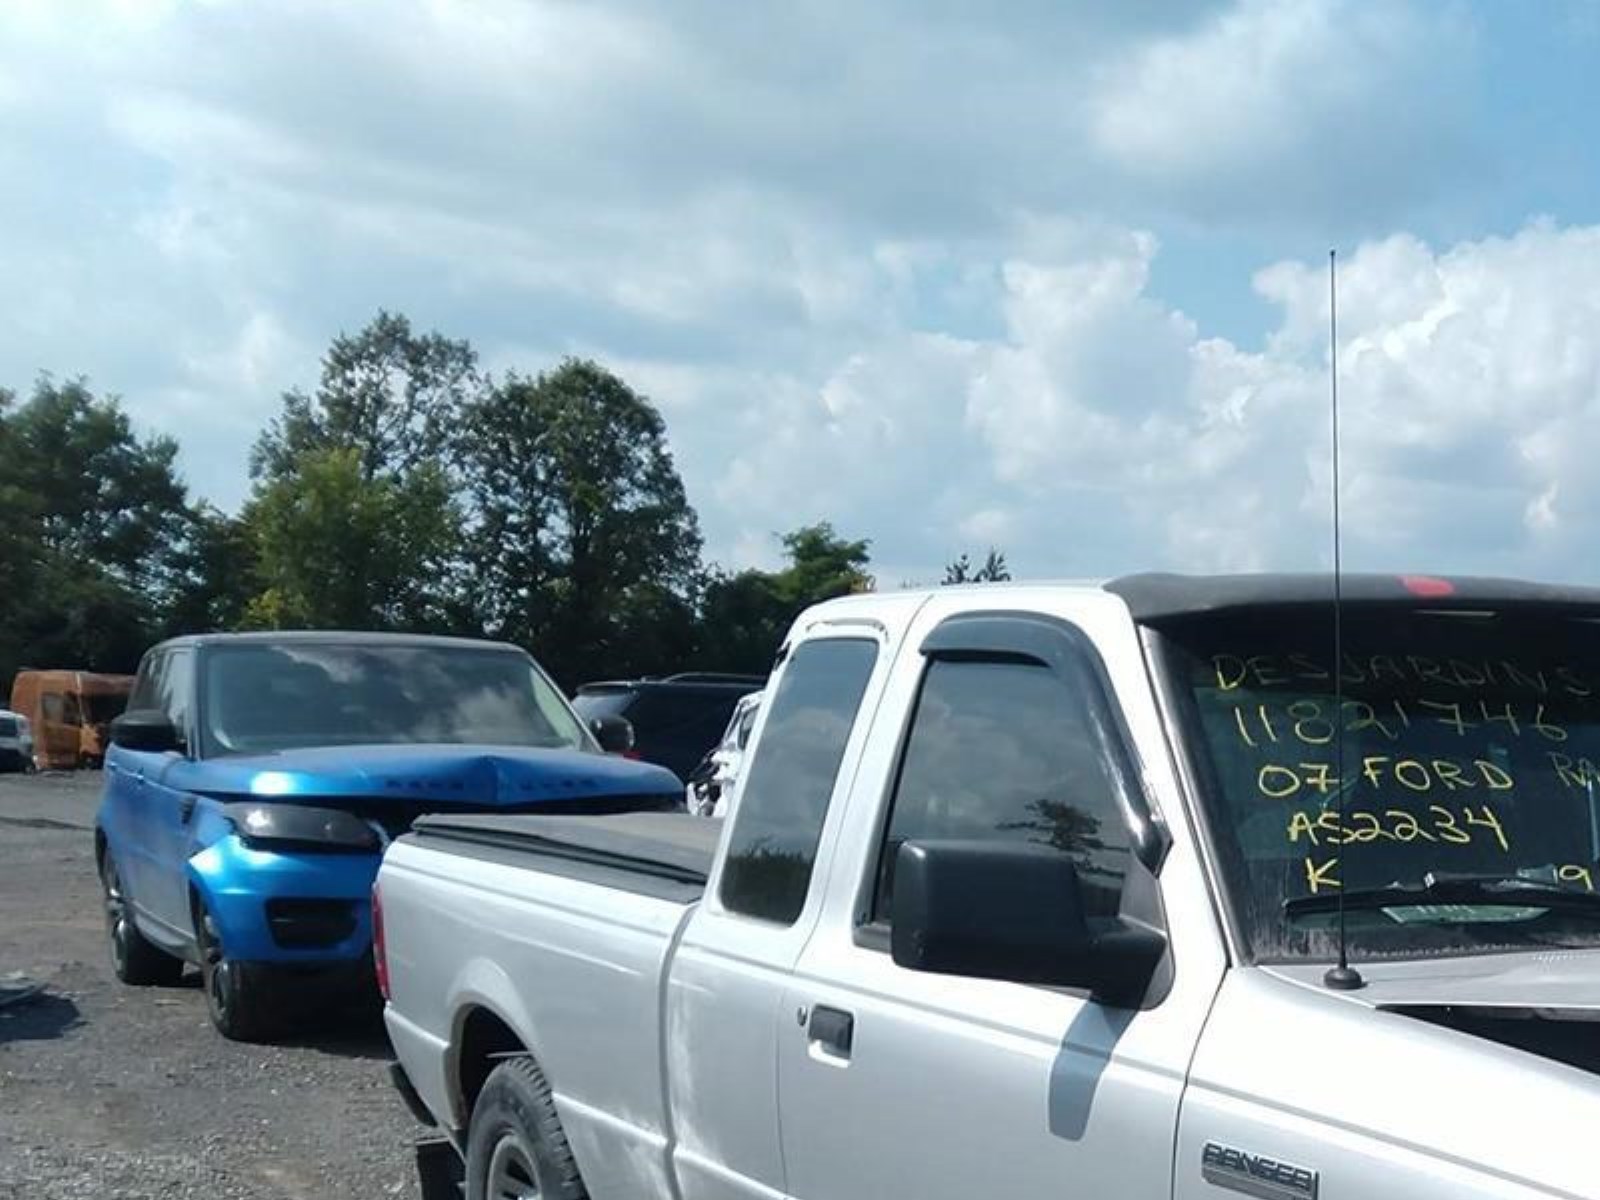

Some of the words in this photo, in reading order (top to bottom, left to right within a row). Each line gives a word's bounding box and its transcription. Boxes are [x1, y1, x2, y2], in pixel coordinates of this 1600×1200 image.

[1234, 699, 1569, 747] 11821746
[1363, 756, 1514, 791] FORD
[1287, 804, 1509, 851] AS2234
[1305, 857, 1342, 894] K
